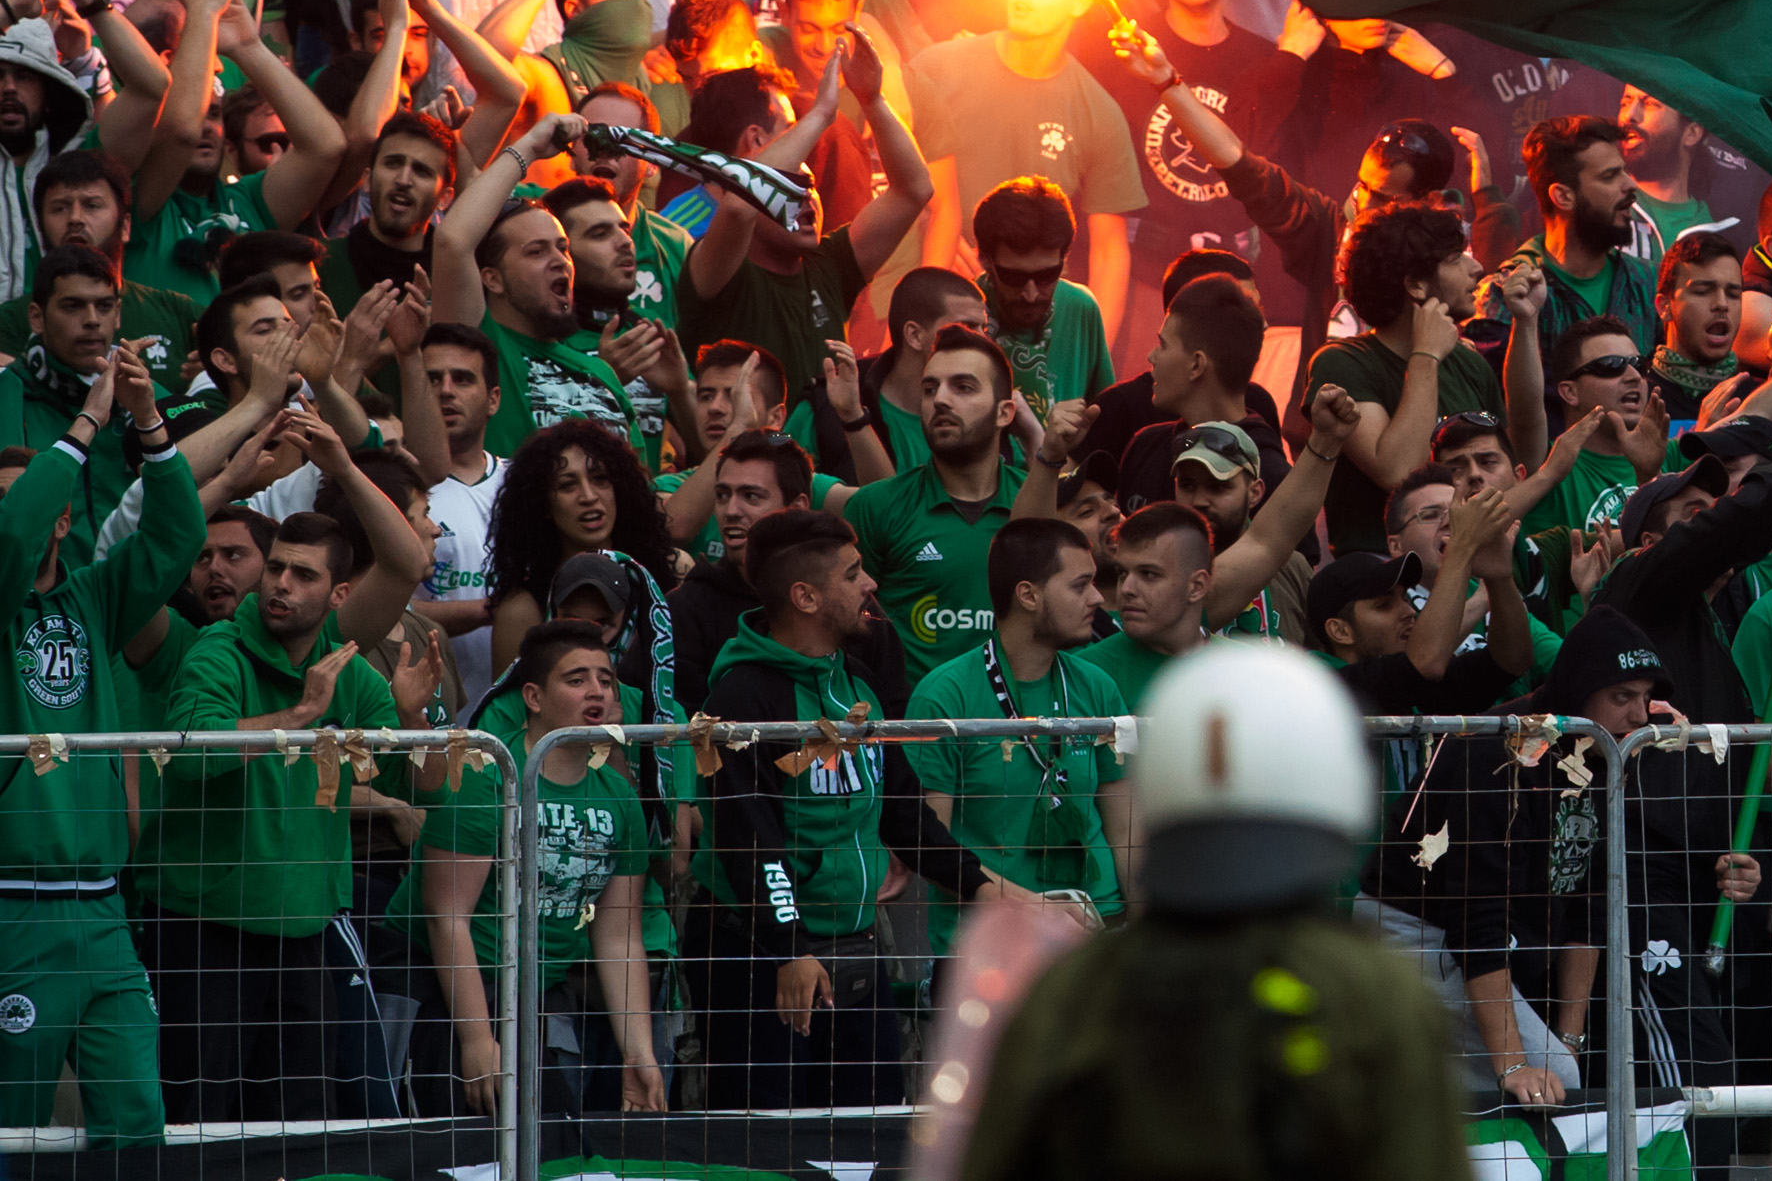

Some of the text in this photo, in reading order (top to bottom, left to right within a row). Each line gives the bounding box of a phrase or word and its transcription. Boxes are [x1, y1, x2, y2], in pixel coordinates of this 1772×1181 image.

[43, 639, 75, 683] 25
[28, 678, 60, 705] GREEN
[583, 807, 615, 836] 13
[763, 859, 800, 924] 1966
